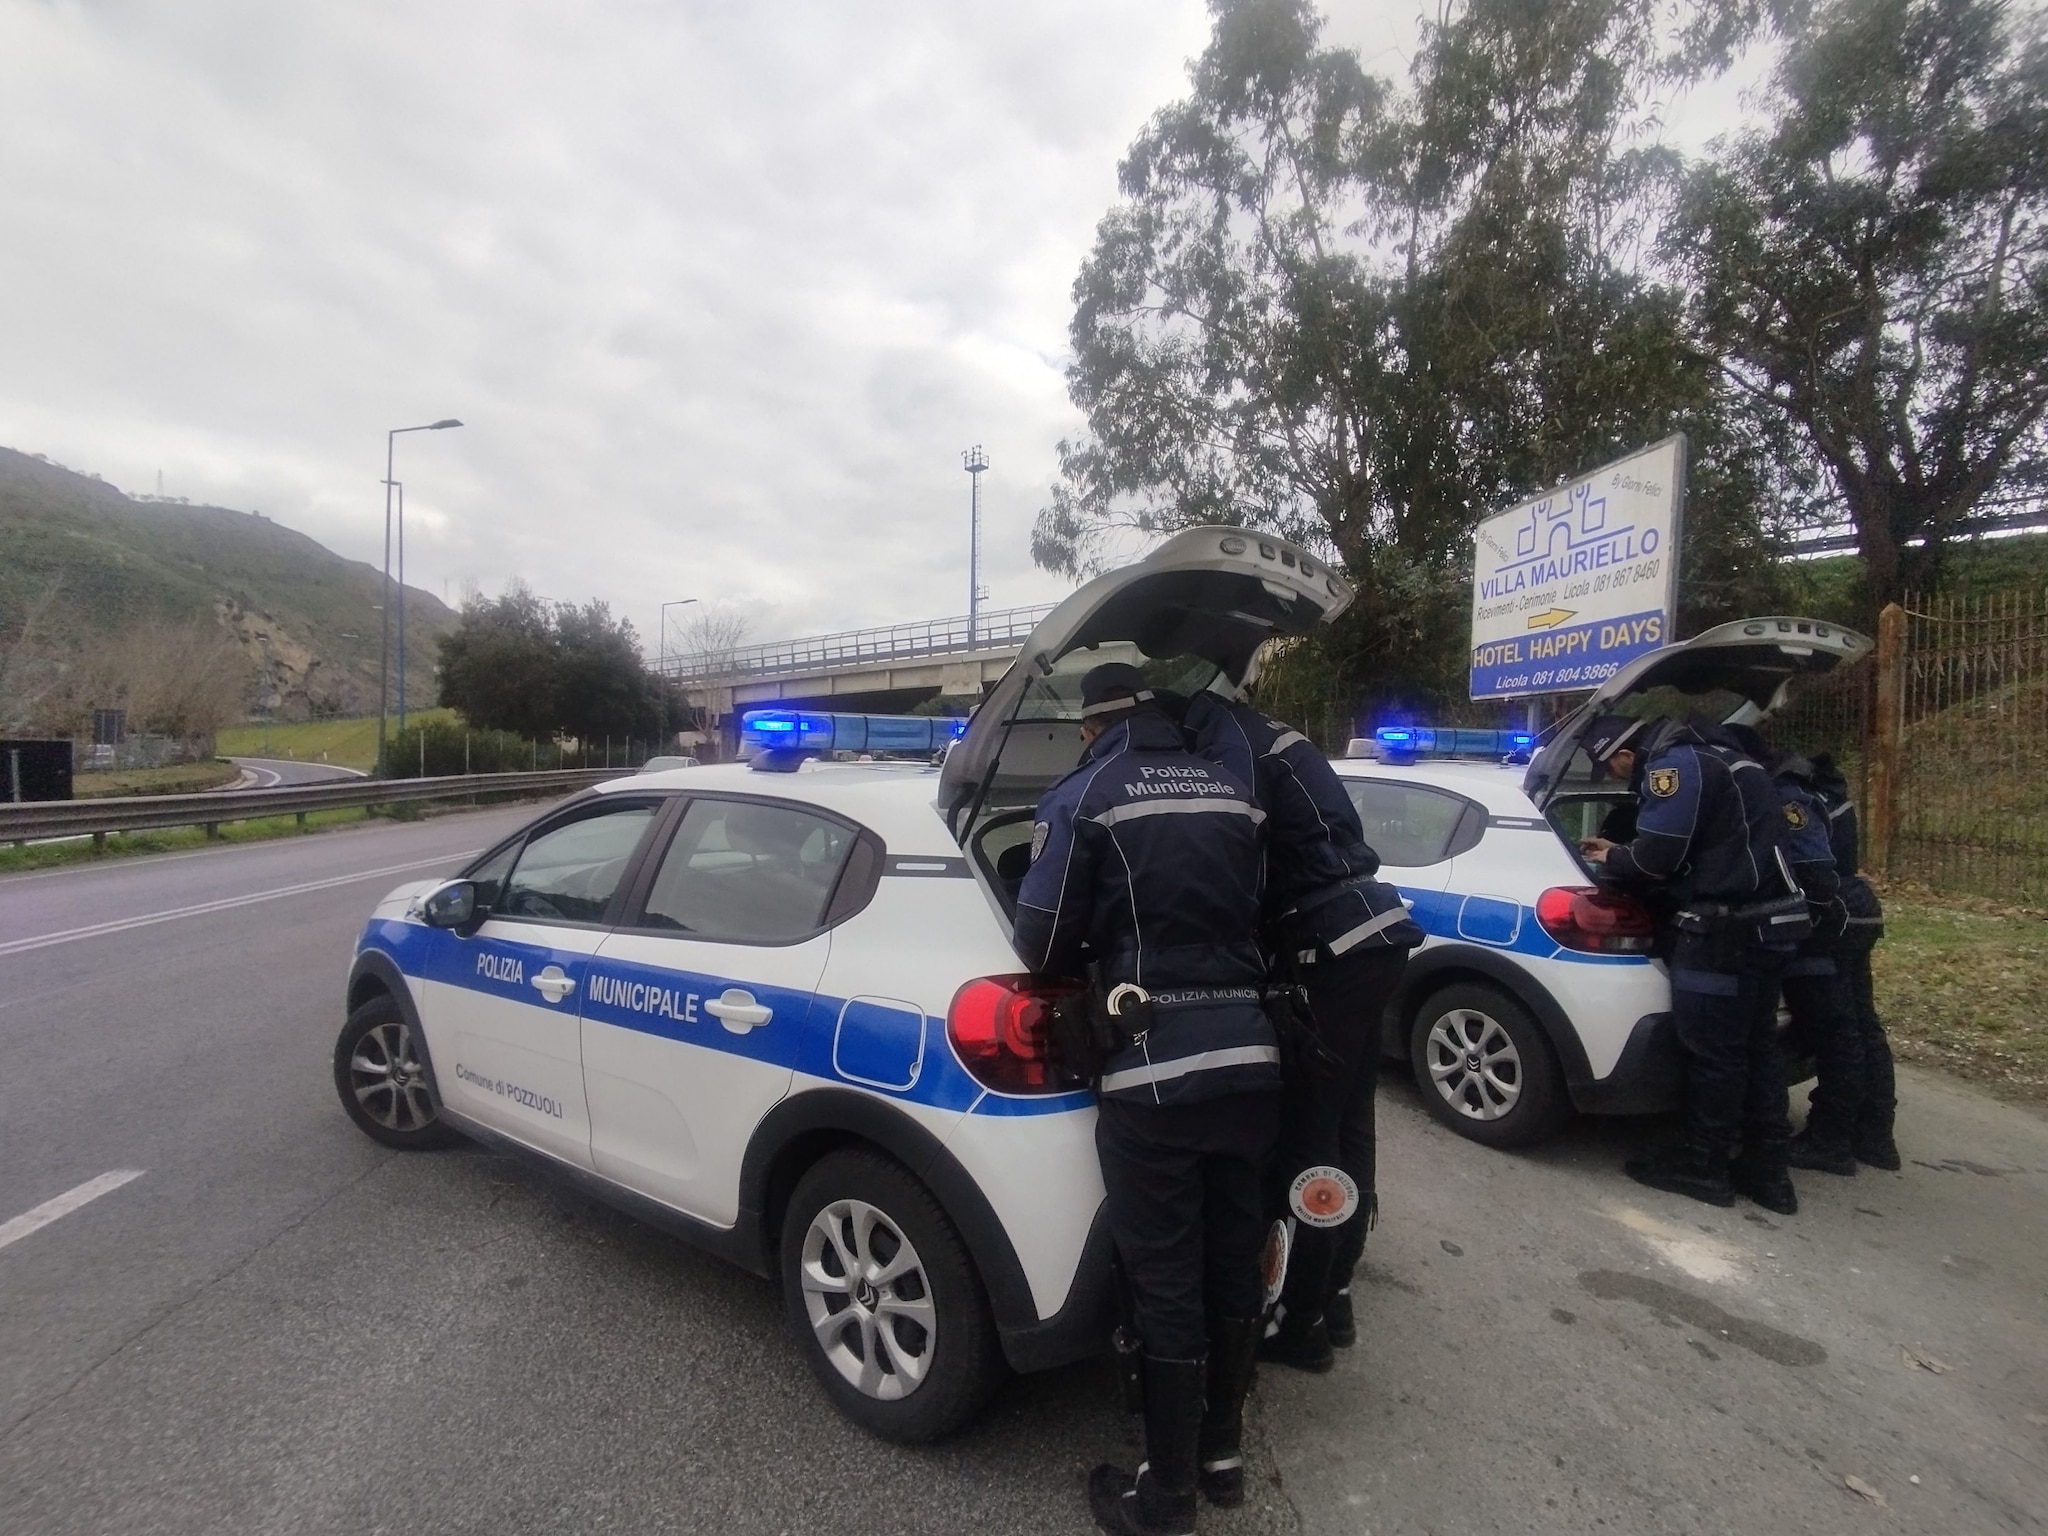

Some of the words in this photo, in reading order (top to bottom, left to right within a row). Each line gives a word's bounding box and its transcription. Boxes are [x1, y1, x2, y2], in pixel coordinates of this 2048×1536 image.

[1480, 570, 1526, 600] VILLA
[1531, 528, 1659, 588] MAURIELLO
[1476, 600, 1515, 622] Ricevimenti
[1519, 588, 1557, 611] Cerimonie
[1563, 578, 1590, 600] Licola
[1593, 575, 1611, 593] 081
[1612, 567, 1633, 588] 867
[1633, 559, 1660, 584] 8460
[1473, 643, 1523, 669] HOTEL
[1530, 629, 1592, 661] HAPPY
[1600, 616, 1661, 650] DAYS
[1496, 673, 1528, 690] Licola
[1531, 670, 1552, 686] 081
[1556, 667, 1579, 682] 804
[1581, 662, 1619, 681] 3866
[1124, 779, 1235, 797] Municipale
[1139, 765, 1209, 779] Polizia
[476, 952, 523, 985] POLIZIA
[589, 974, 699, 1024] MUNICIPALE
[456, 1063, 494, 1092] Comune
[495, 1083, 505, 1097] di
[507, 1084, 563, 1119] POZZUOLI
